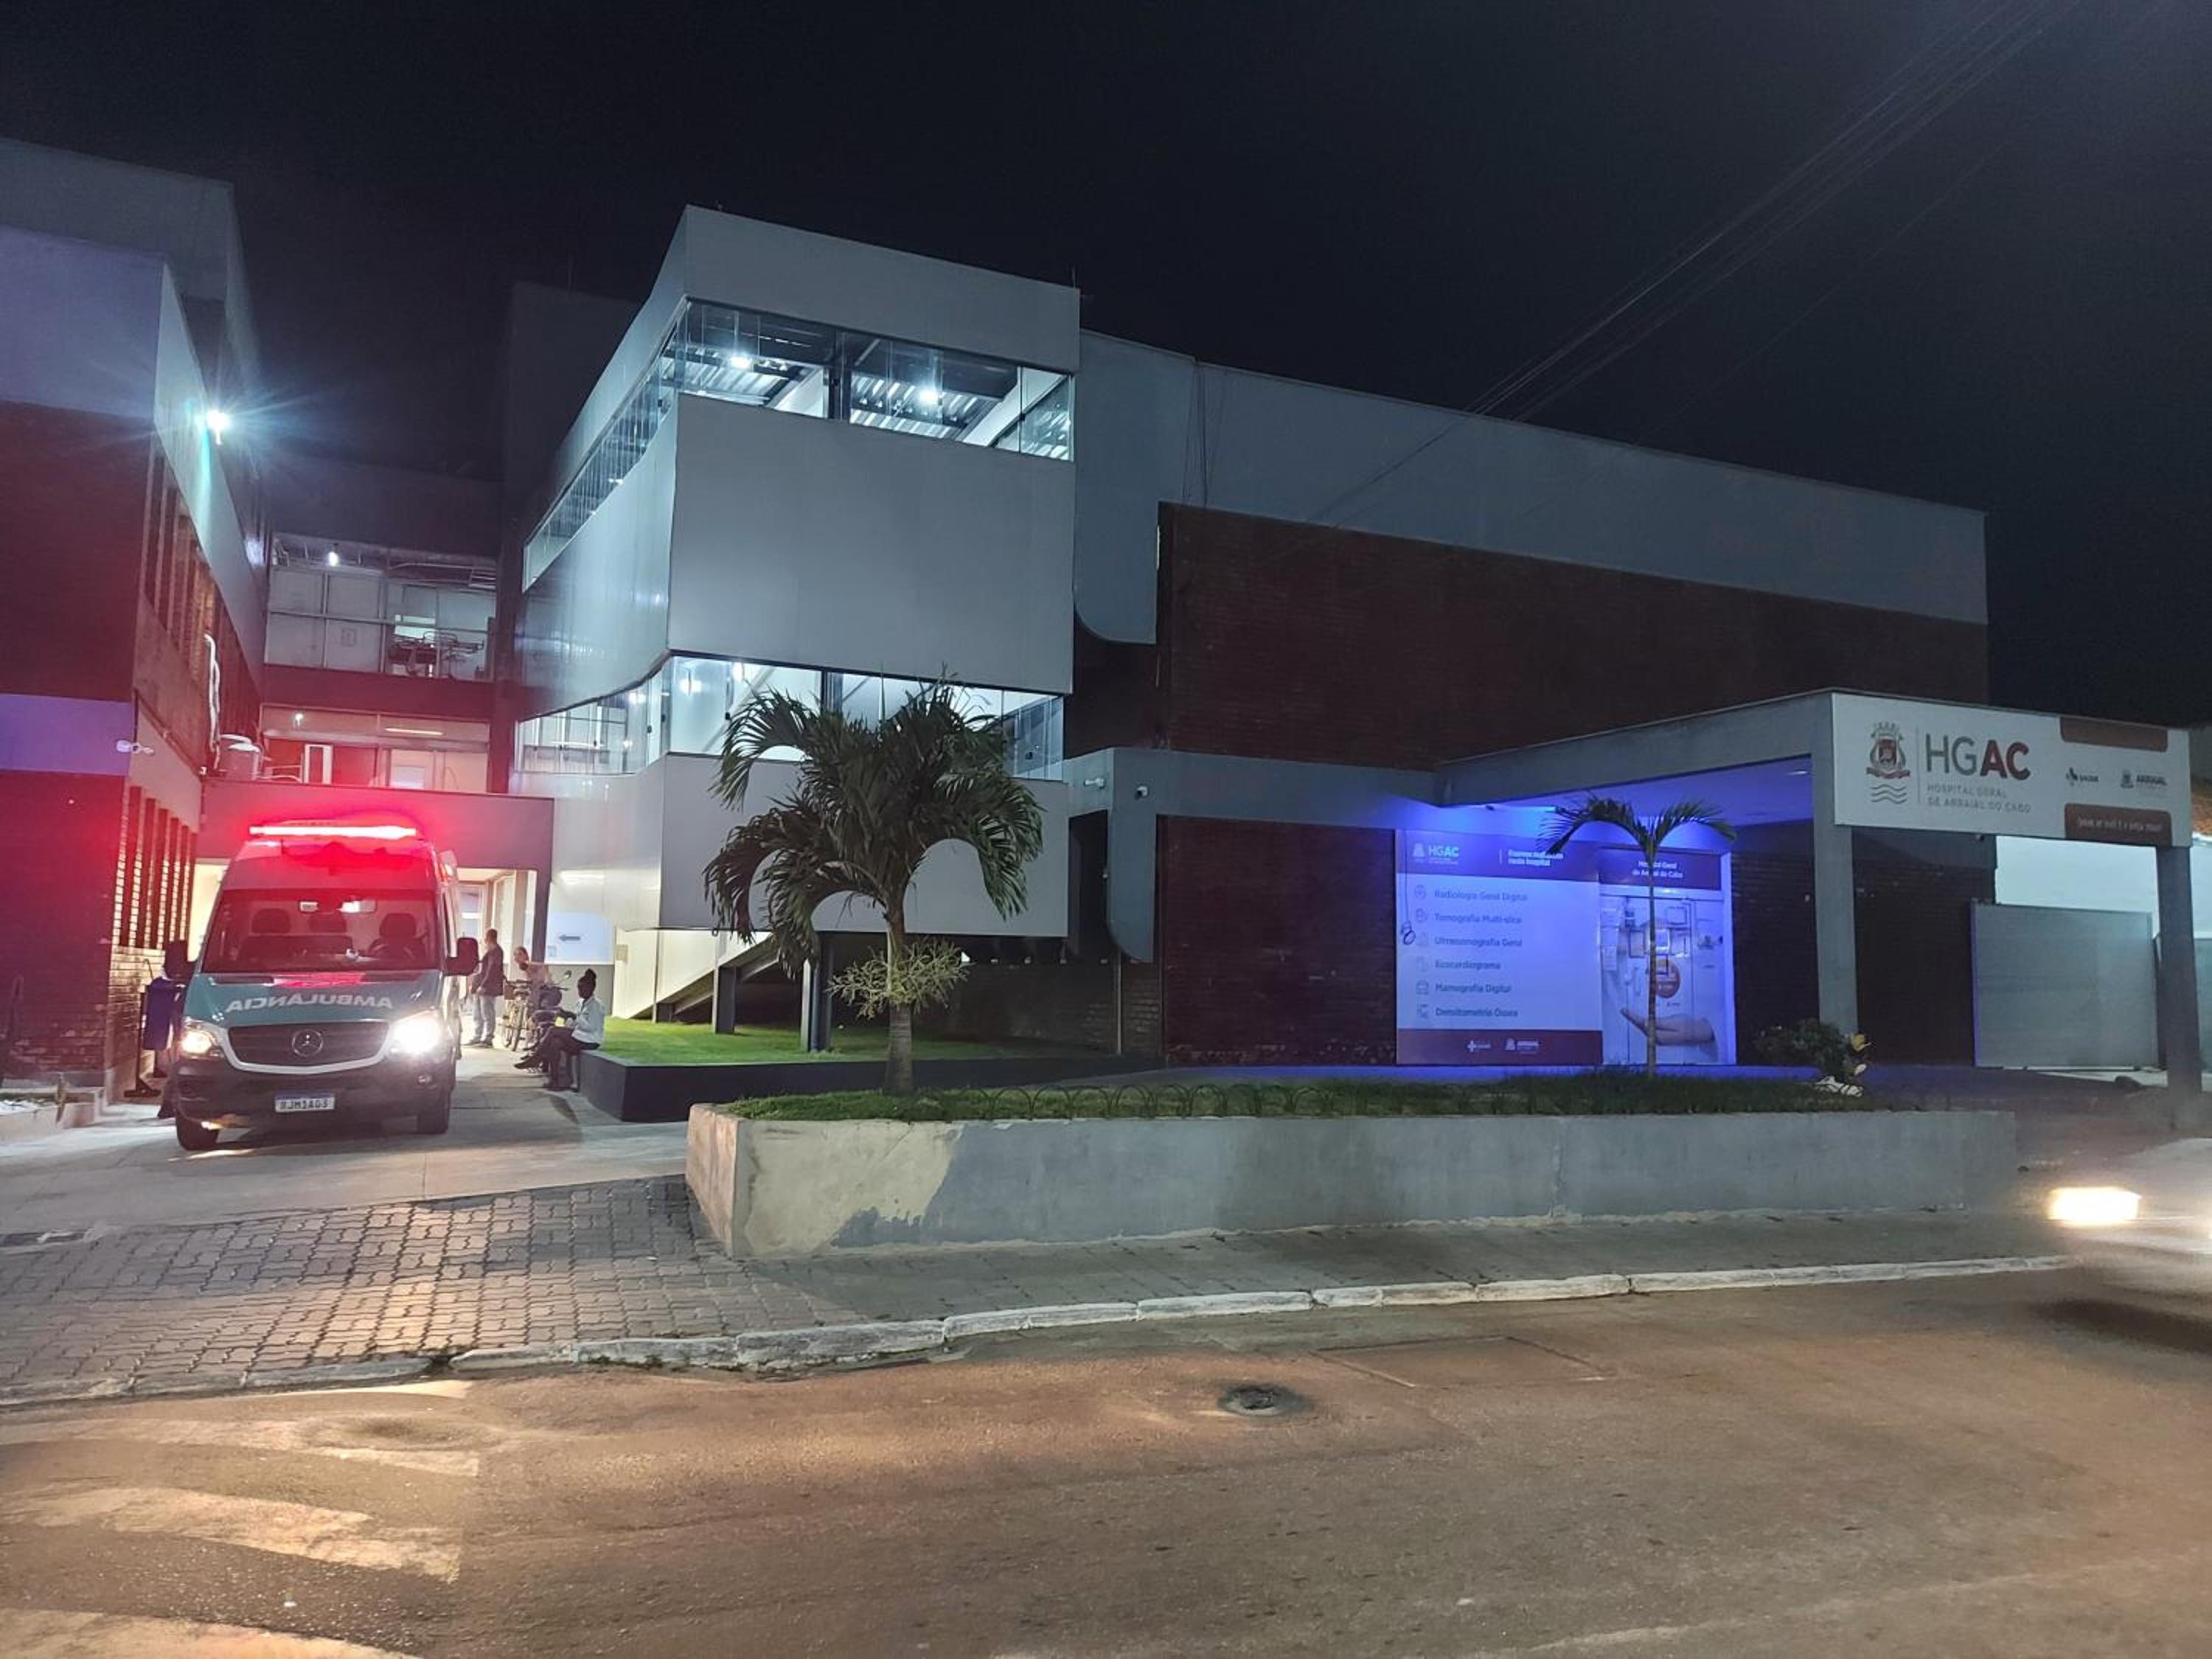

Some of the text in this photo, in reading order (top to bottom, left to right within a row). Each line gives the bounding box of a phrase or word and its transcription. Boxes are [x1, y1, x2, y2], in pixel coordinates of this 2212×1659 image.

[1926, 733, 2031, 780] HGAC
[1927, 784, 2006, 799] HOSPITAL GERAL
[1927, 796, 1941, 807] DE
[2005, 802, 2031, 814] CABO
[1428, 845, 1460, 858] HGAC
[1434, 890, 1477, 901] Radiologia
[1434, 913, 1480, 923] Tomografia
[1435, 984, 1512, 994] Mamografia Digital
